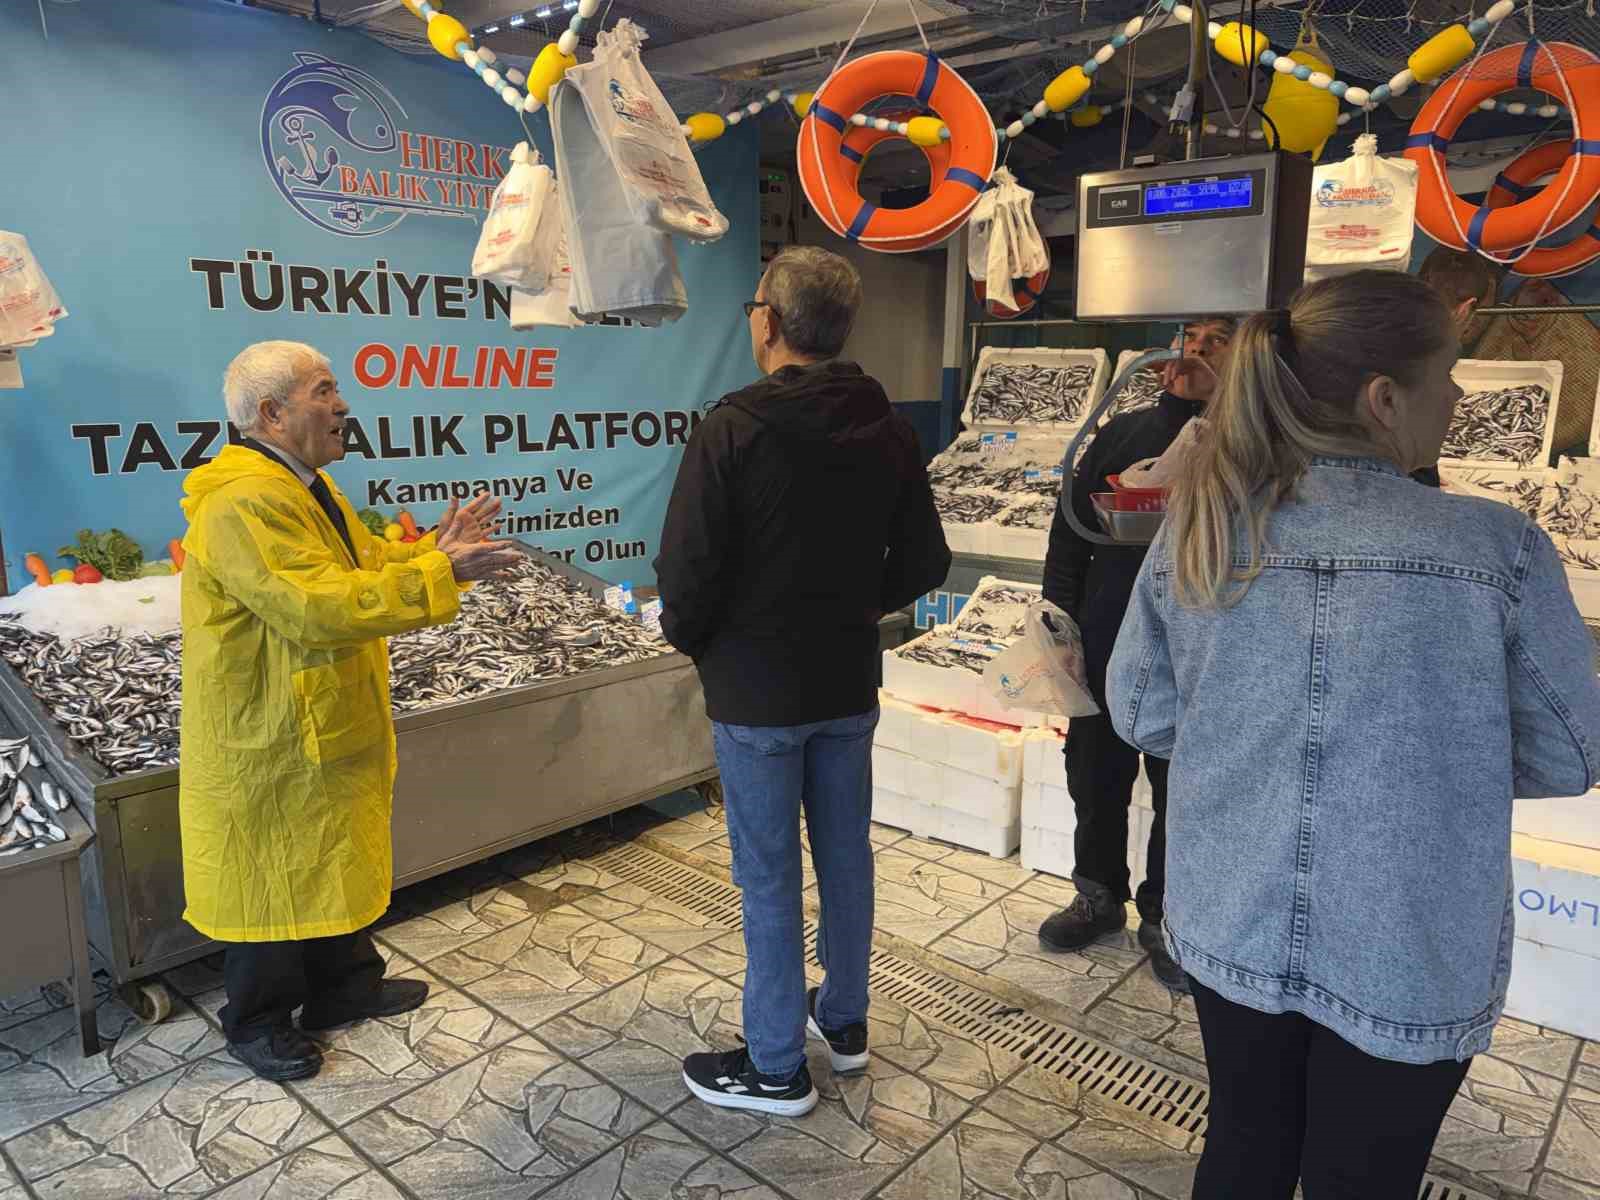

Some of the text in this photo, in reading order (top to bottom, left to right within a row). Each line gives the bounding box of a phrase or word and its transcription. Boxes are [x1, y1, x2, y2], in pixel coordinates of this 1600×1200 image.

[398, 130, 513, 179] HERK
[337, 166, 432, 202] BALIK
[190, 249, 512, 321] TÜRKİYE’N
[352, 342, 560, 389] ONLINE
[71, 418, 243, 475] TAZ
[343, 414, 470, 460] ALIK
[366, 467, 594, 507] Kampanya Ve
[480, 503, 621, 536] rimizden
[584, 538, 646, 564] Olun
